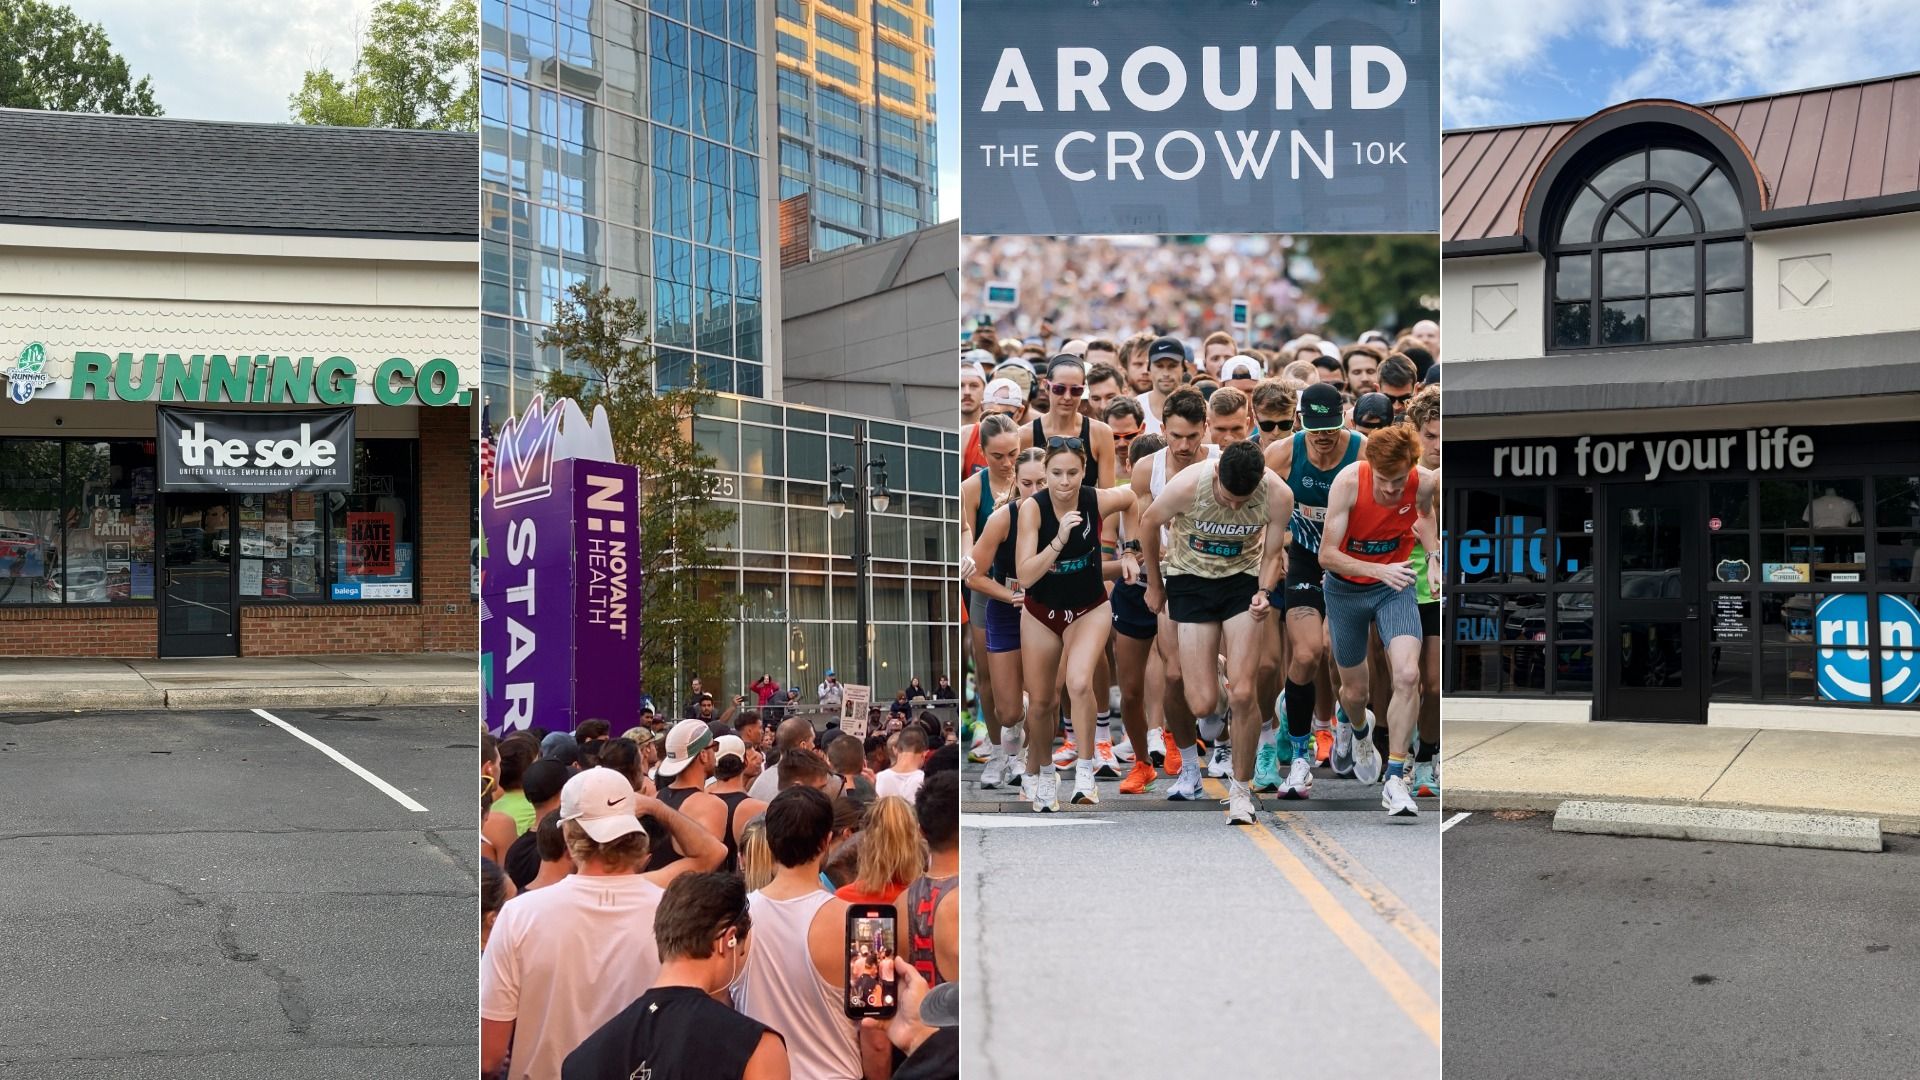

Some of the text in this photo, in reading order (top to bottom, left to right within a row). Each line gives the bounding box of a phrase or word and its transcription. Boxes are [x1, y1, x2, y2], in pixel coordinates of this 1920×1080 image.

[980, 45, 1408, 112] AROUND
[980, 130, 1408, 181] THE CROWN 10K
[373, 357, 473, 407] CO.
[178, 421, 337, 468] the sole
[1493, 427, 1815, 481] run for your life
[207, 468, 214, 476] IN
[216, 468, 239, 476] MILES.
[241, 468, 282, 476] EMPOWERED
[284, 468, 293, 476] BY
[295, 468, 313, 476] EACH
[315, 468, 337, 476] OTHER
[95, 523, 130, 536] FAITH
[351, 523, 391, 542] HATE
[351, 544, 391, 561] LOVE
[334, 587, 359, 596] balega
[588, 538, 607, 624] HEALTH
[1456, 617, 1500, 642] RUN
[1820, 619, 1913, 660] run
